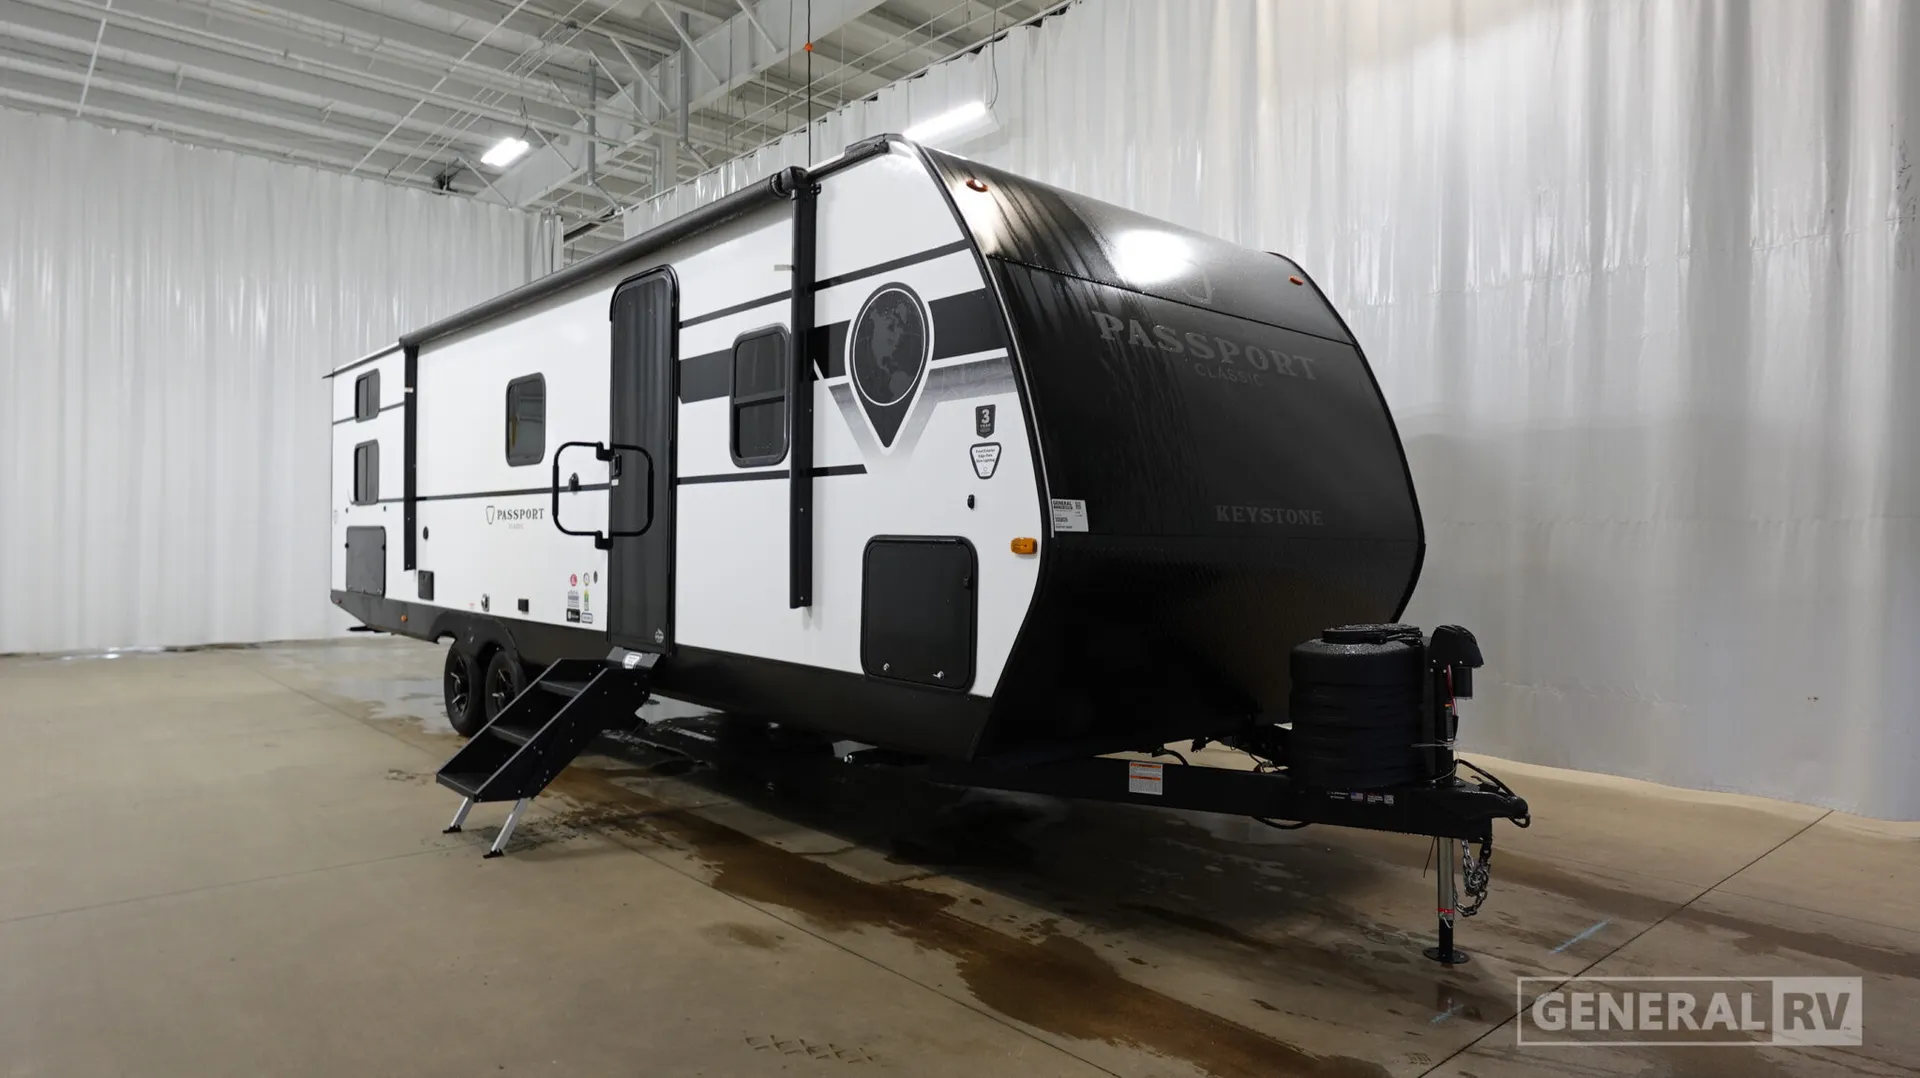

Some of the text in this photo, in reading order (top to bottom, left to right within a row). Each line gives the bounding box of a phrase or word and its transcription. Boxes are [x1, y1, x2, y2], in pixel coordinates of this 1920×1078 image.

[1091, 310, 1317, 380] PASSPORT
[1194, 362, 1265, 387] CLASSIC
[981, 408, 990, 424] 3
[497, 508, 544, 520] PASSPORT
[1214, 504, 1324, 526] KEYSTONE
